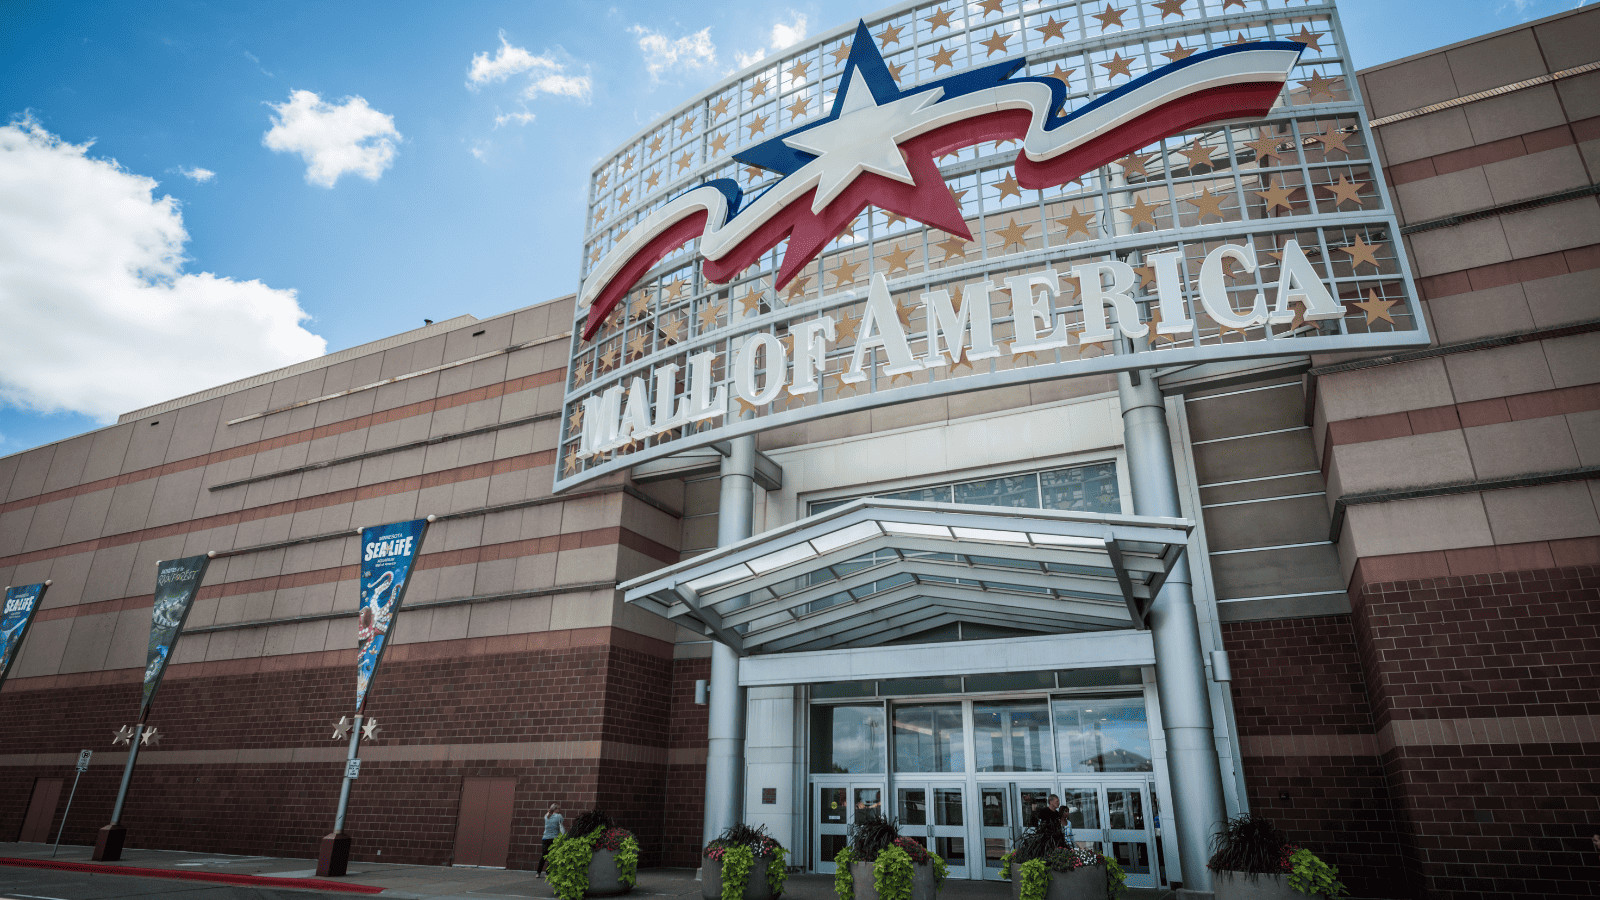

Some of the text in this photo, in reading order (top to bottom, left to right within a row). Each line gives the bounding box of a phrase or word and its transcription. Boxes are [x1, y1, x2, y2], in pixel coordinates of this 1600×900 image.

[576, 239, 1347, 460] MALL OF AMERICA
[364, 541, 387, 561] SEA
